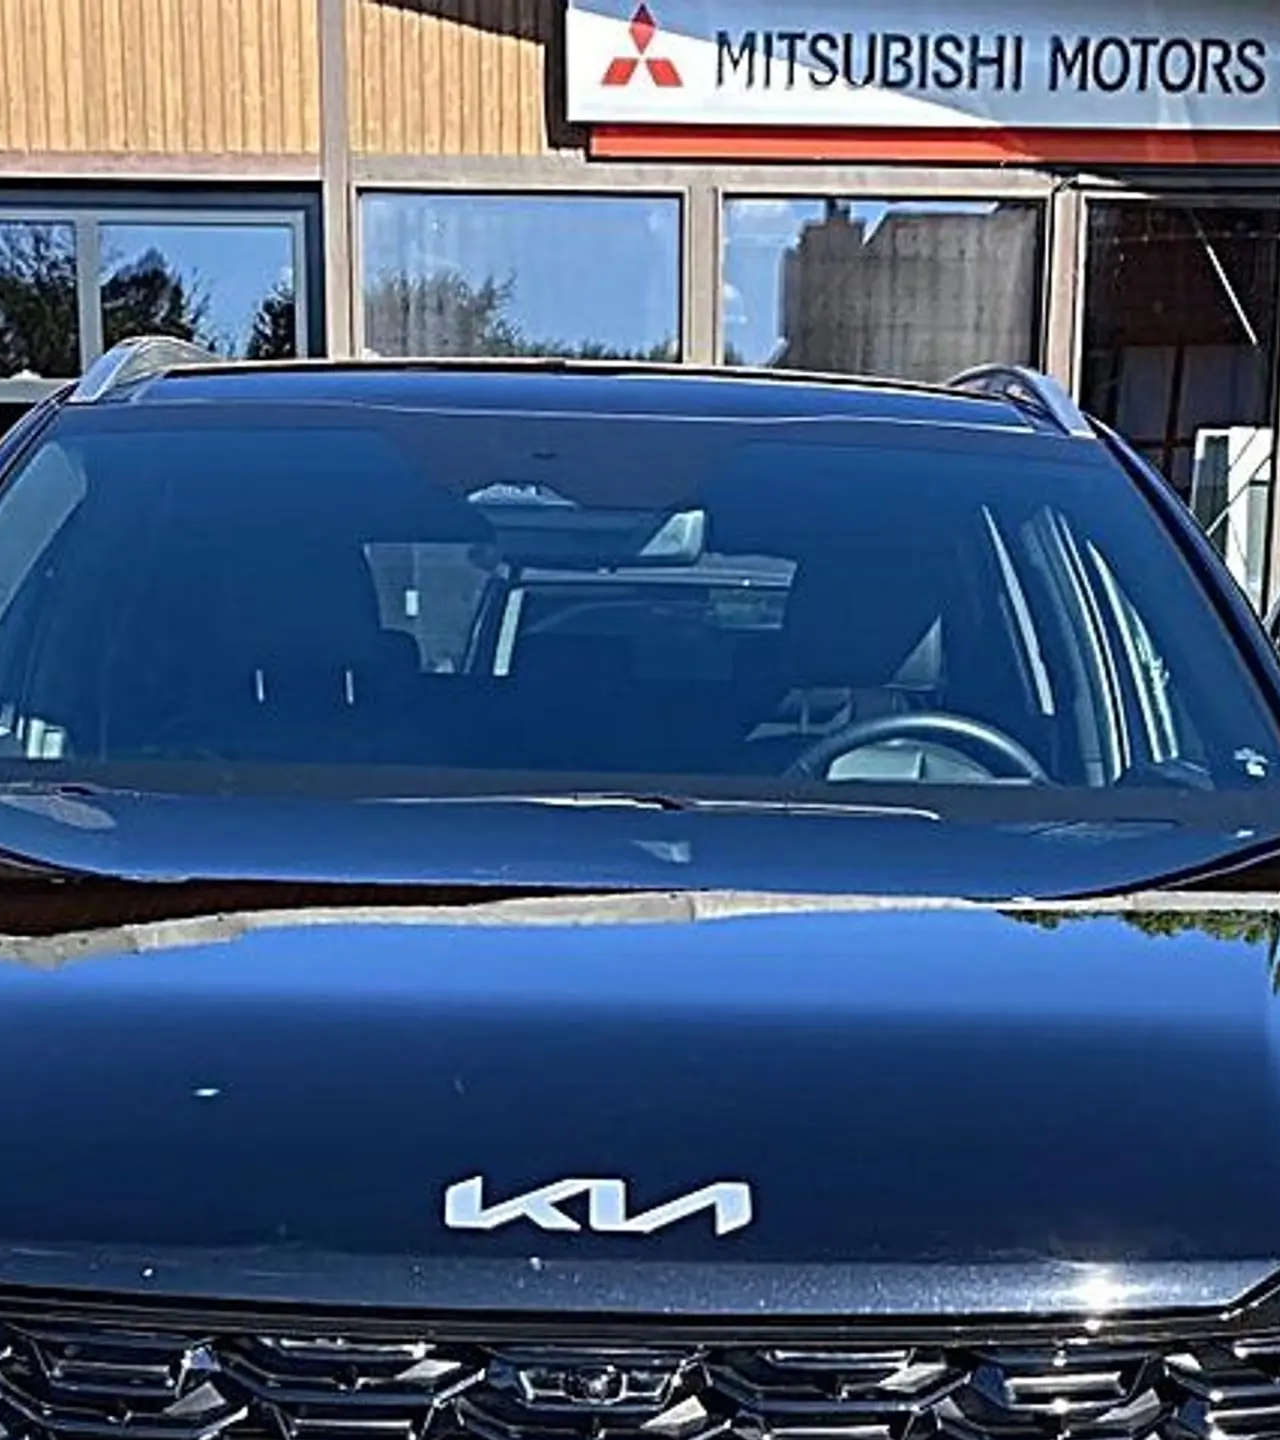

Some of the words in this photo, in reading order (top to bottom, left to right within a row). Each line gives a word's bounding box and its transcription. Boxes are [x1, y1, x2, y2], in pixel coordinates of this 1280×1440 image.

[716, 31, 1022, 88] MITSUBISHI
[1048, 36, 1266, 94] MOTORS
[445, 1176, 752, 1235] KIA
